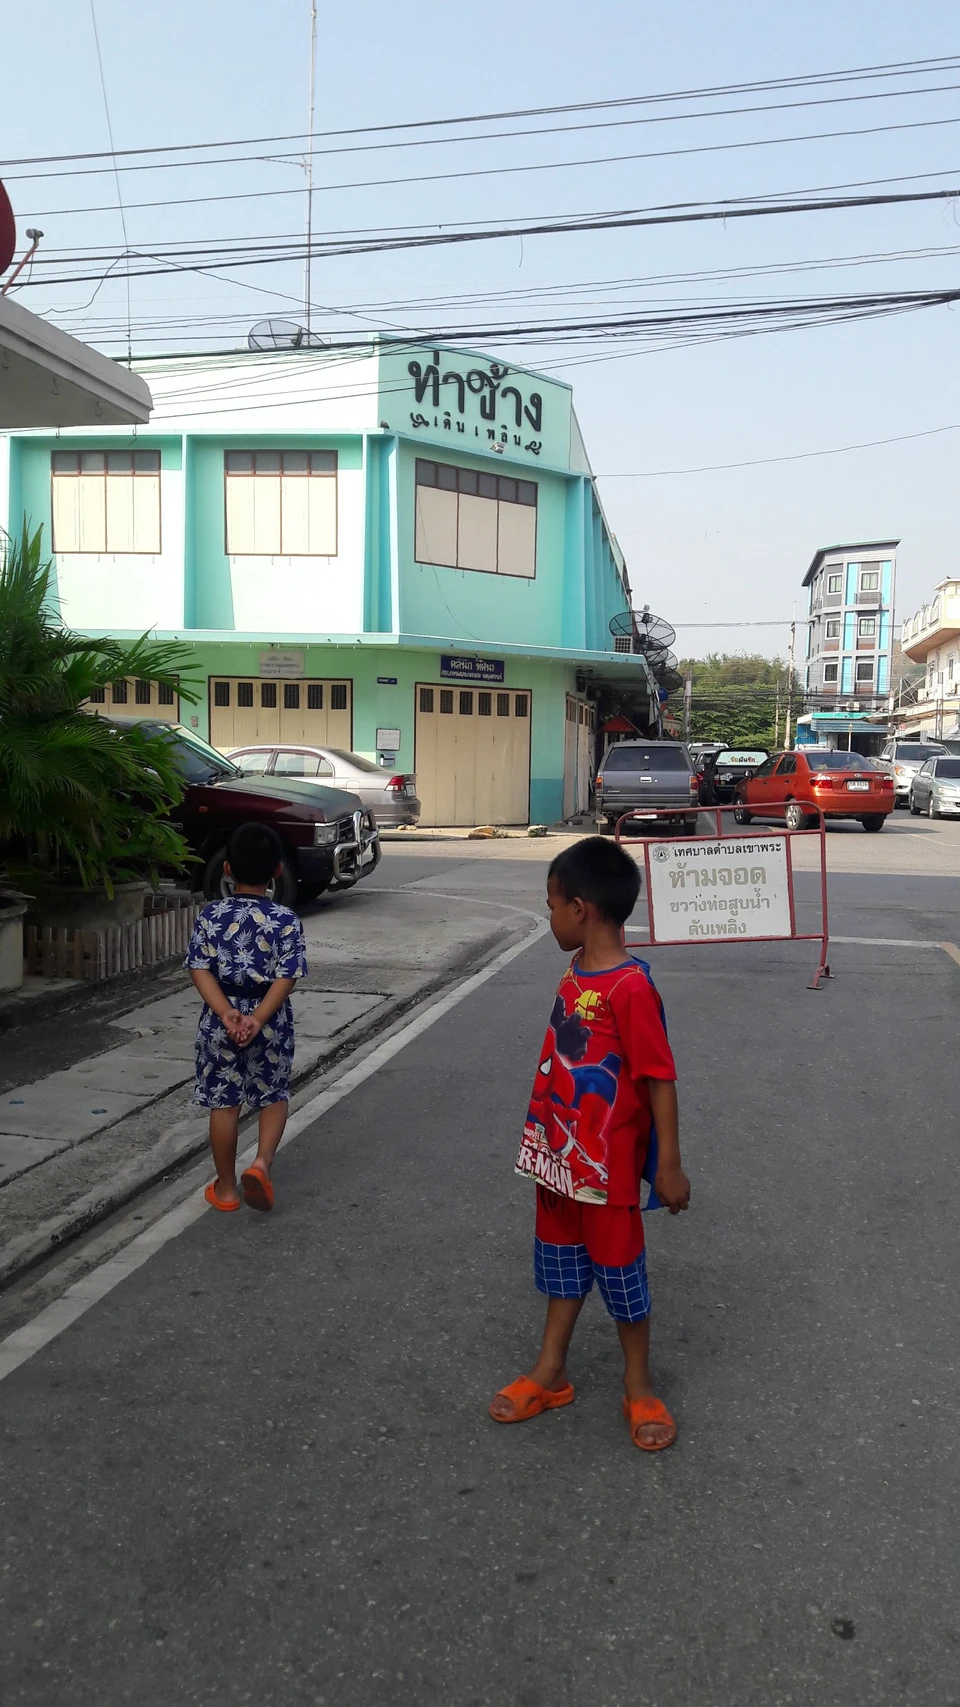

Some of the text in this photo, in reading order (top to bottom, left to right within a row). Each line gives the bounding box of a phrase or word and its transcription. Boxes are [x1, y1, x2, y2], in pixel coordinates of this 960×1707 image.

[408, 351, 542, 432] ท่าช้าง
[668, 862, 767, 889] ห้ามจอด
[688, 918, 747, 936] ดับเพลิง
